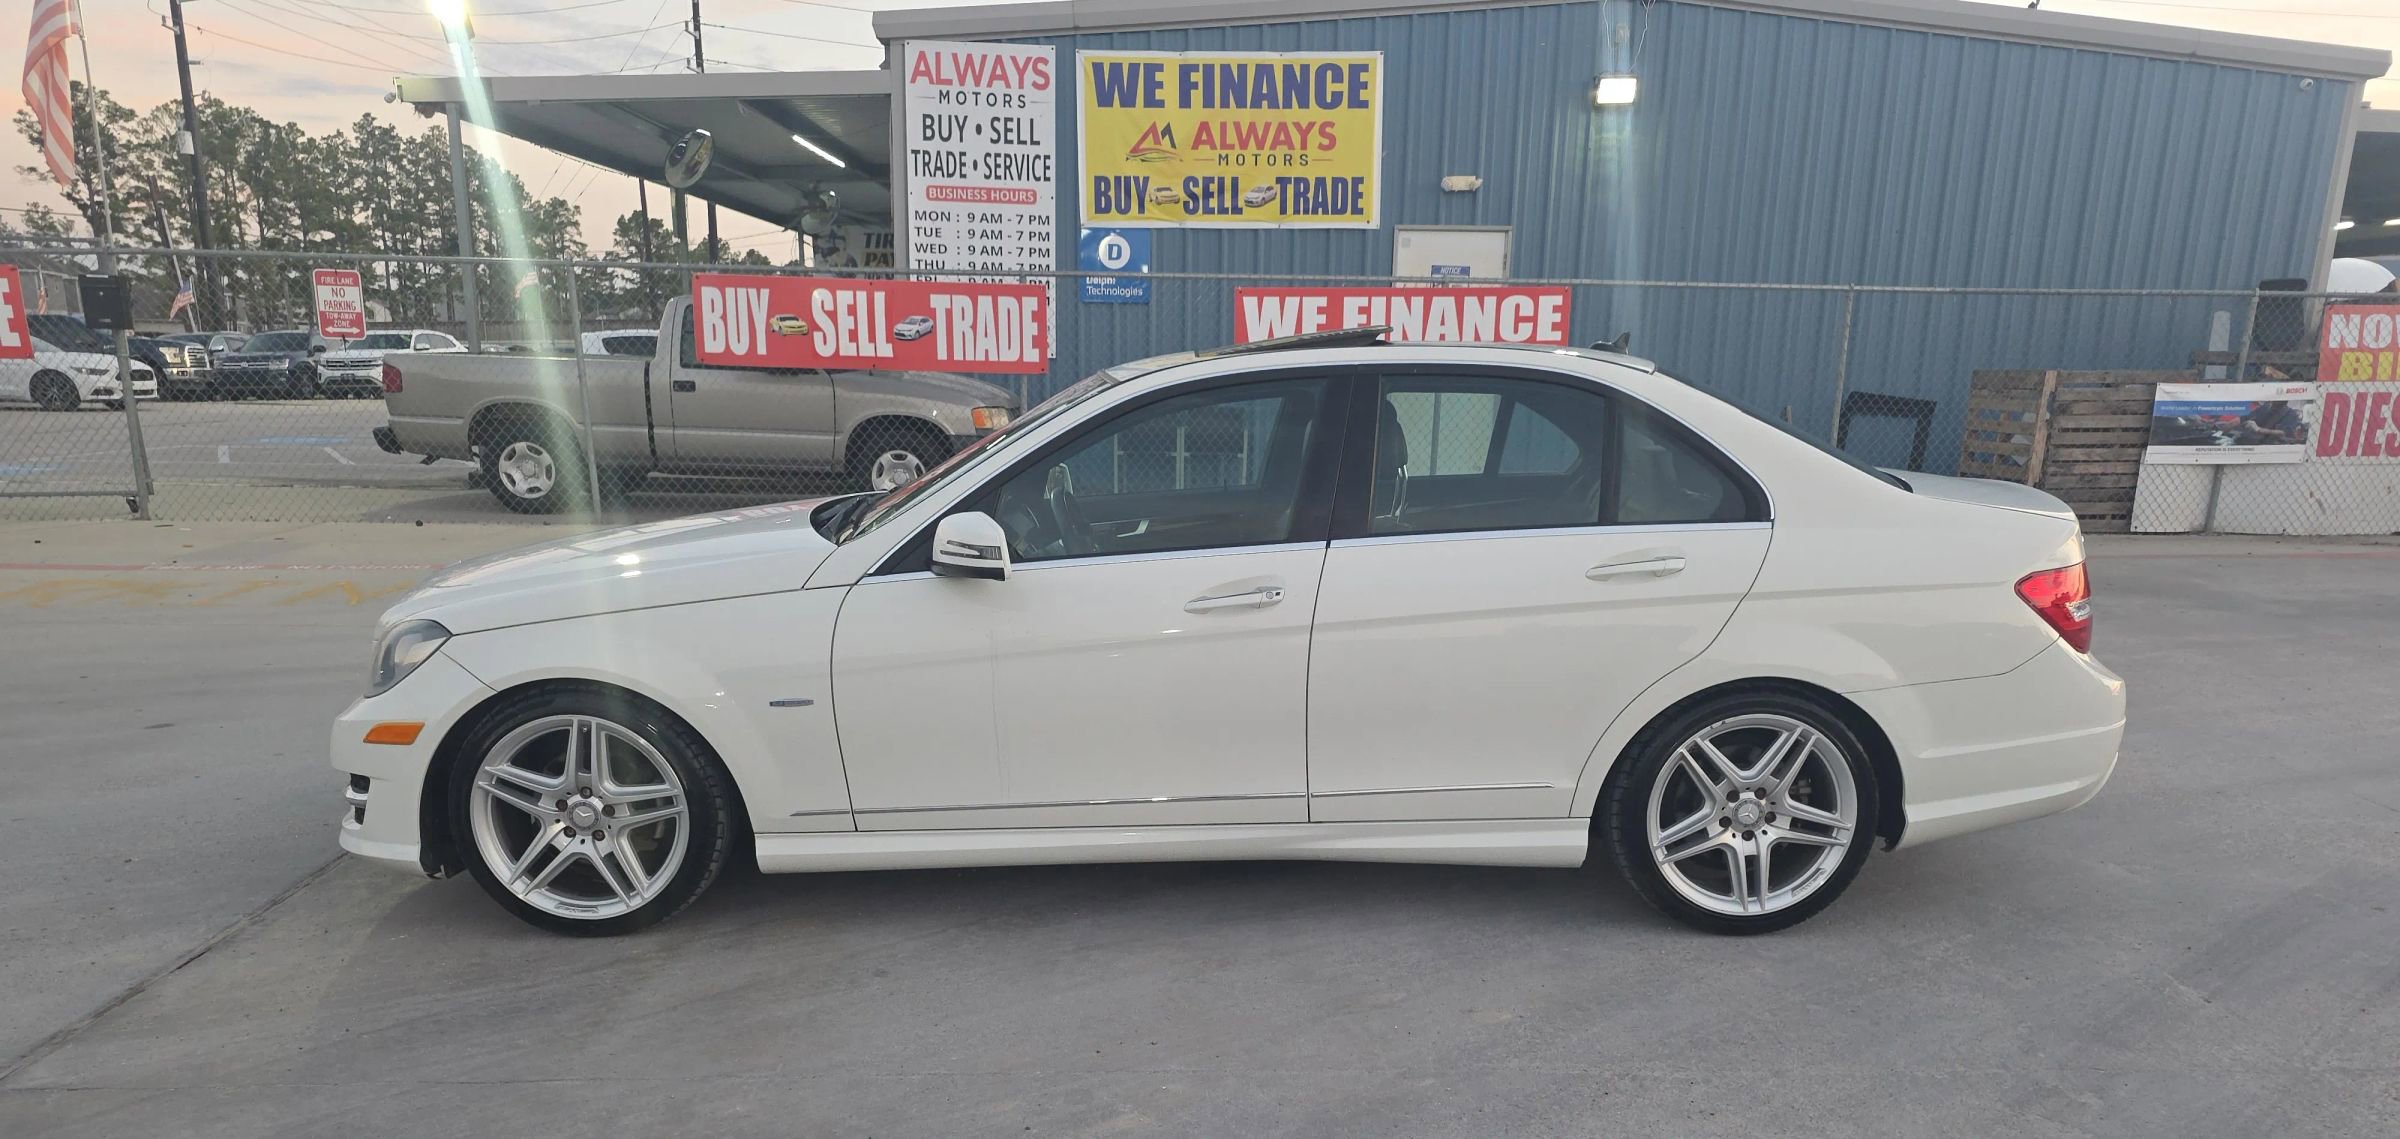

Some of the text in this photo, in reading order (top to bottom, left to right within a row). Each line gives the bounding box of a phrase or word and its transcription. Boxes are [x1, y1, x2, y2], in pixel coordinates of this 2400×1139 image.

[910, 50, 1050, 91] ALWAYS
[1092, 61, 1370, 110] WE FINANCE
[939, 89, 1026, 108] MOTORS
[922, 113, 1041, 146] BUY SELL
[1190, 120, 1337, 151] ALWAYS
[911, 148, 1051, 182] TRADE SERVICE
[1218, 153, 1309, 167] MOTORS
[928, 186, 1034, 203] BUSINESS HOURS
[1094, 175, 1364, 216] BUY SELL TRADE
[914, 210, 951, 222] MON
[967, 212, 975, 223] 9
[979, 213, 1003, 224] AM
[1015, 214, 1024, 225] 7
[1028, 215, 1051, 226] PM
[914, 226, 942, 238] TUE
[967, 228, 975, 239] 9
[979, 229, 1003, 240] AM
[1015, 230, 1024, 242] 7
[1028, 231, 1051, 242] PM
[914, 243, 948, 255] WED
[968, 245, 976, 256] 9
[979, 245, 1003, 257] AM
[1015, 247, 1024, 258] 7
[1028, 247, 1051, 259] PM
[915, 259, 946, 270] THU
[968, 261, 976, 271] 9
[980, 262, 1003, 272] AM
[1028, 263, 1051, 272] PM
[1440, 266, 1461, 274] NOTICE
[320, 276, 354, 285] FIRE LANE
[331, 287, 346, 298] NO
[1086, 286, 1143, 298] Technologies
[323, 300, 356, 311] PARKING
[326, 312, 357, 320] TOW-AWAY
[333, 320, 351, 328] ZONE
[700, 286, 1040, 362] BUY SELL TRADE
[1243, 294, 1563, 342] WE FINANCE
[2328, 313, 2400, 349] NO
[2337, 351, 2400, 381] BI
[2285, 387, 2308, 395] BOSCH
